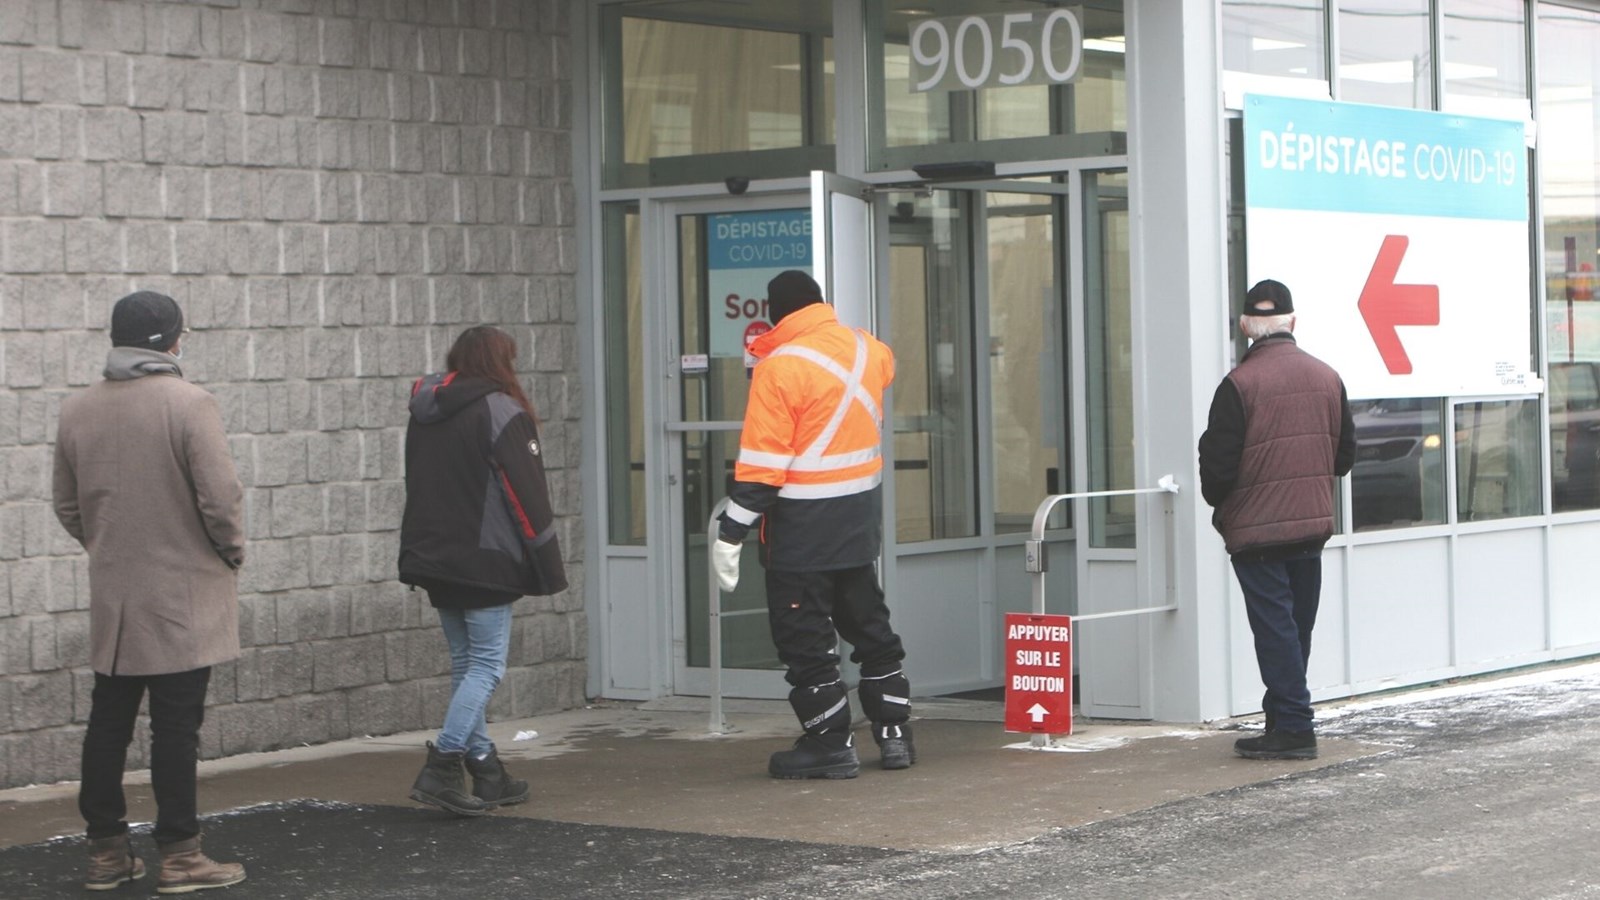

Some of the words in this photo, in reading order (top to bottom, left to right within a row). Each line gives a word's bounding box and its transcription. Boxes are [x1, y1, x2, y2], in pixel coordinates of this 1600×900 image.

[912, 8, 1081, 91] 9050
[1259, 121, 1406, 178] DÉPISTAGE
[1413, 143, 1516, 186] COVID-19
[716, 219, 812, 240] DÉPISTAGE
[729, 243, 807, 262] COVID-19
[1008, 624, 1069, 642] APPUYER
[1016, 650, 1042, 666] SUR
[1045, 651, 1061, 667] LE
[1012, 675, 1064, 692] BOUTON
